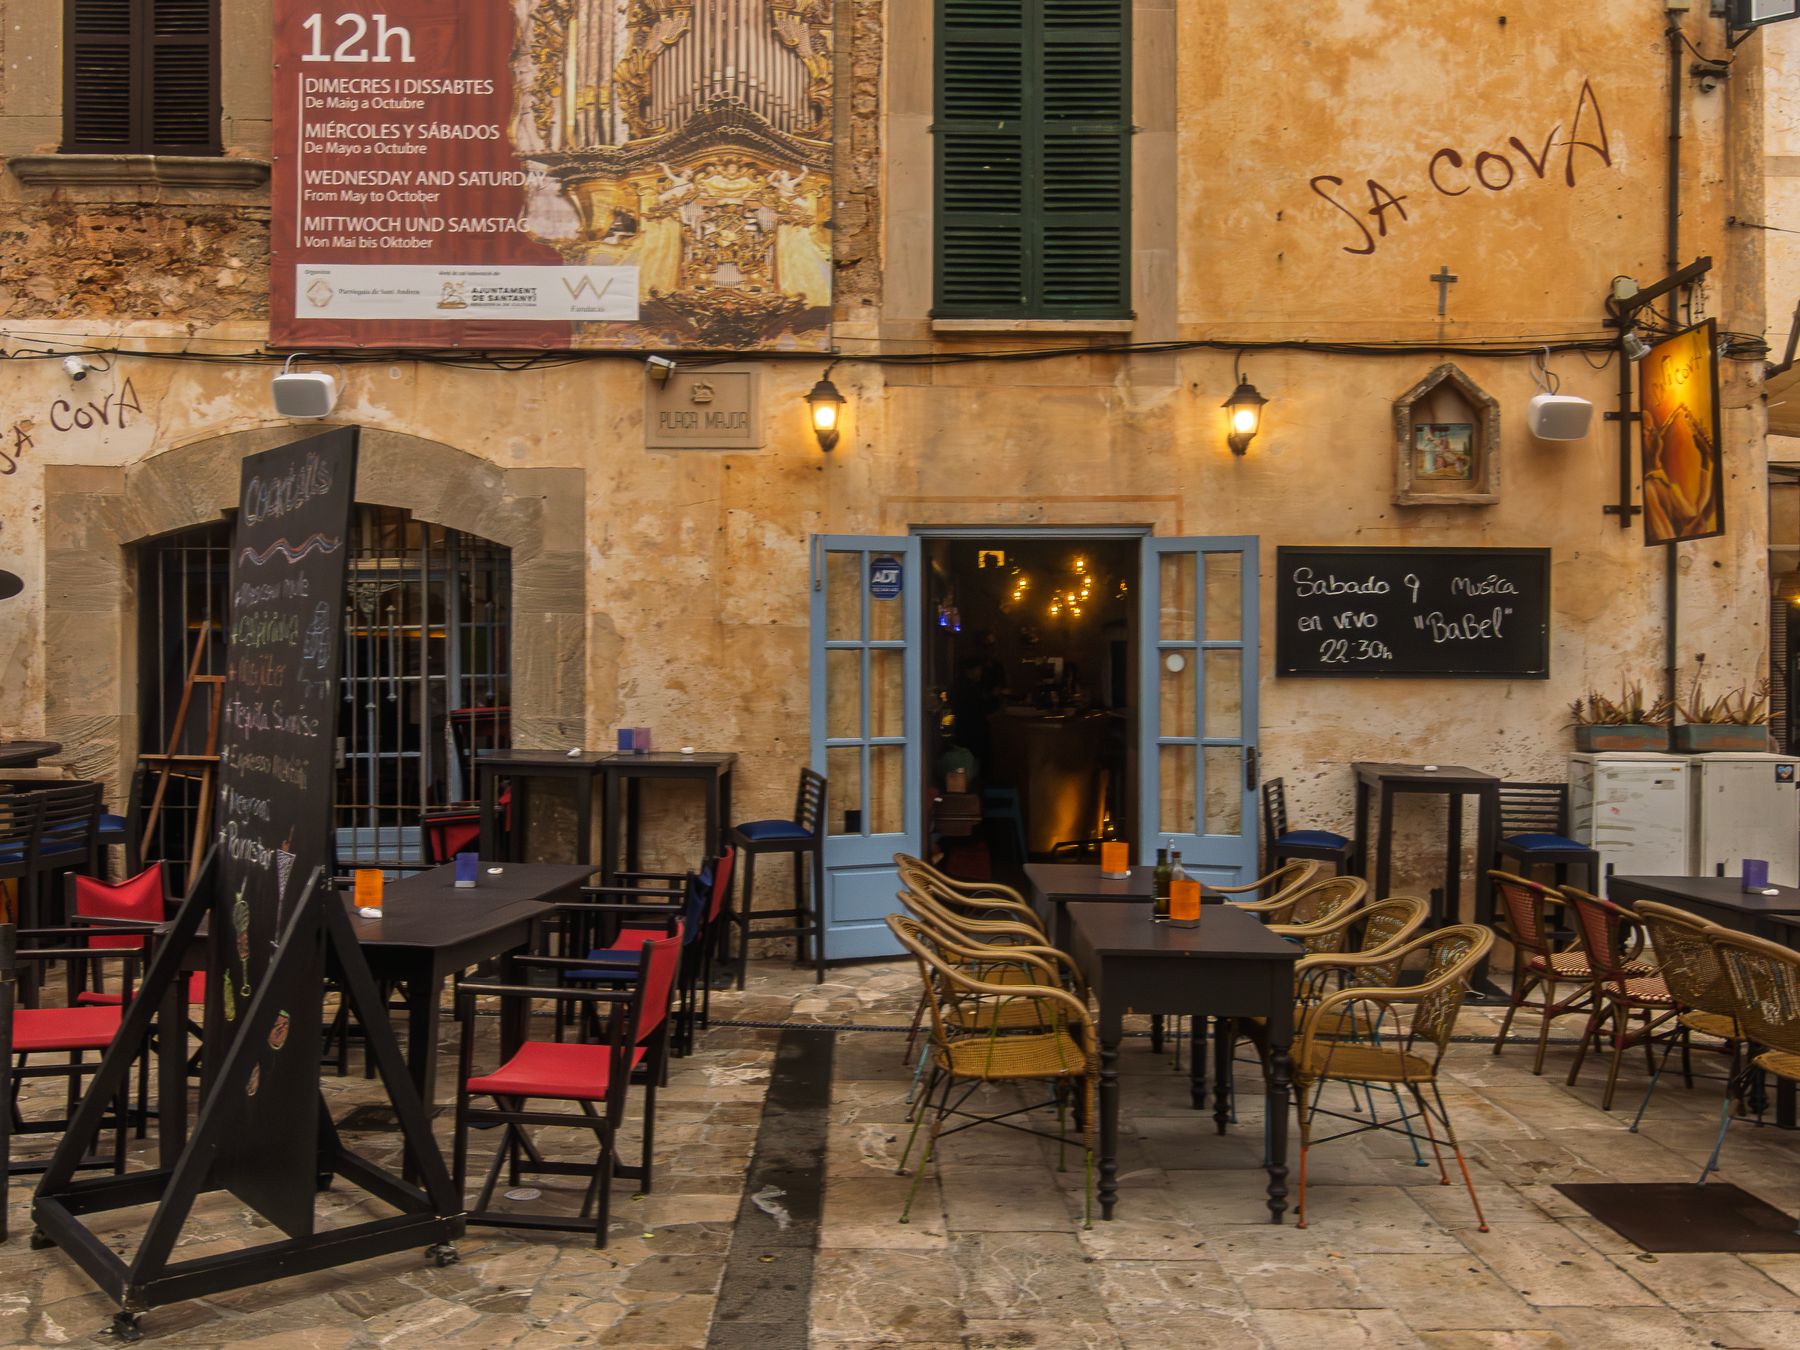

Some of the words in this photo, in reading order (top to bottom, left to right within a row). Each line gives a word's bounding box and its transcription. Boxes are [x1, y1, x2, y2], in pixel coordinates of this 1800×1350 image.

[301, 13, 416, 63] 12h
[304, 78, 391, 95] DIMECRES
[395, 79, 400, 95] I
[403, 79, 494, 96] DISSABTES
[305, 97, 324, 109] De
[326, 97, 358, 112] Maig
[361, 100, 369, 109] a
[371, 97, 425, 110] Octubre
[304, 120, 400, 139] MIÉRCOLES
[403, 124, 414, 139] Y
[418, 121, 500, 140] SÁBADOS
[304, 142, 323, 154] De
[326, 142, 361, 157] Mayo
[364, 146, 371, 154] a
[374, 142, 427, 155] Octubre
[1310, 174, 1408, 255] SA
[1429, 78, 1612, 197] COVA
[304, 170, 412, 186] WEDNESDAY
[415, 171, 454, 186] AND
[458, 171, 546, 187] SATURDAY
[304, 190, 337, 202] From
[340, 190, 367, 205] May
[370, 191, 384, 202] to
[386, 190, 440, 203] October
[304, 216, 401, 232] MITTWOCH
[405, 217, 445, 232] UND
[448, 217, 530, 233] SAMSTAG
[304, 237, 333, 248] Von
[336, 237, 357, 248] Mai
[359, 236, 378, 248] bis
[380, 236, 433, 249] Oktober
[50, 376, 143, 432] COVA
[872, 569, 899, 584] ADT
[1293, 567, 1391, 597] Sabado
[1403, 573, 1421, 604] 9
[1297, 614, 1323, 632] en
[1319, 639, 1393, 663] 22:30h
